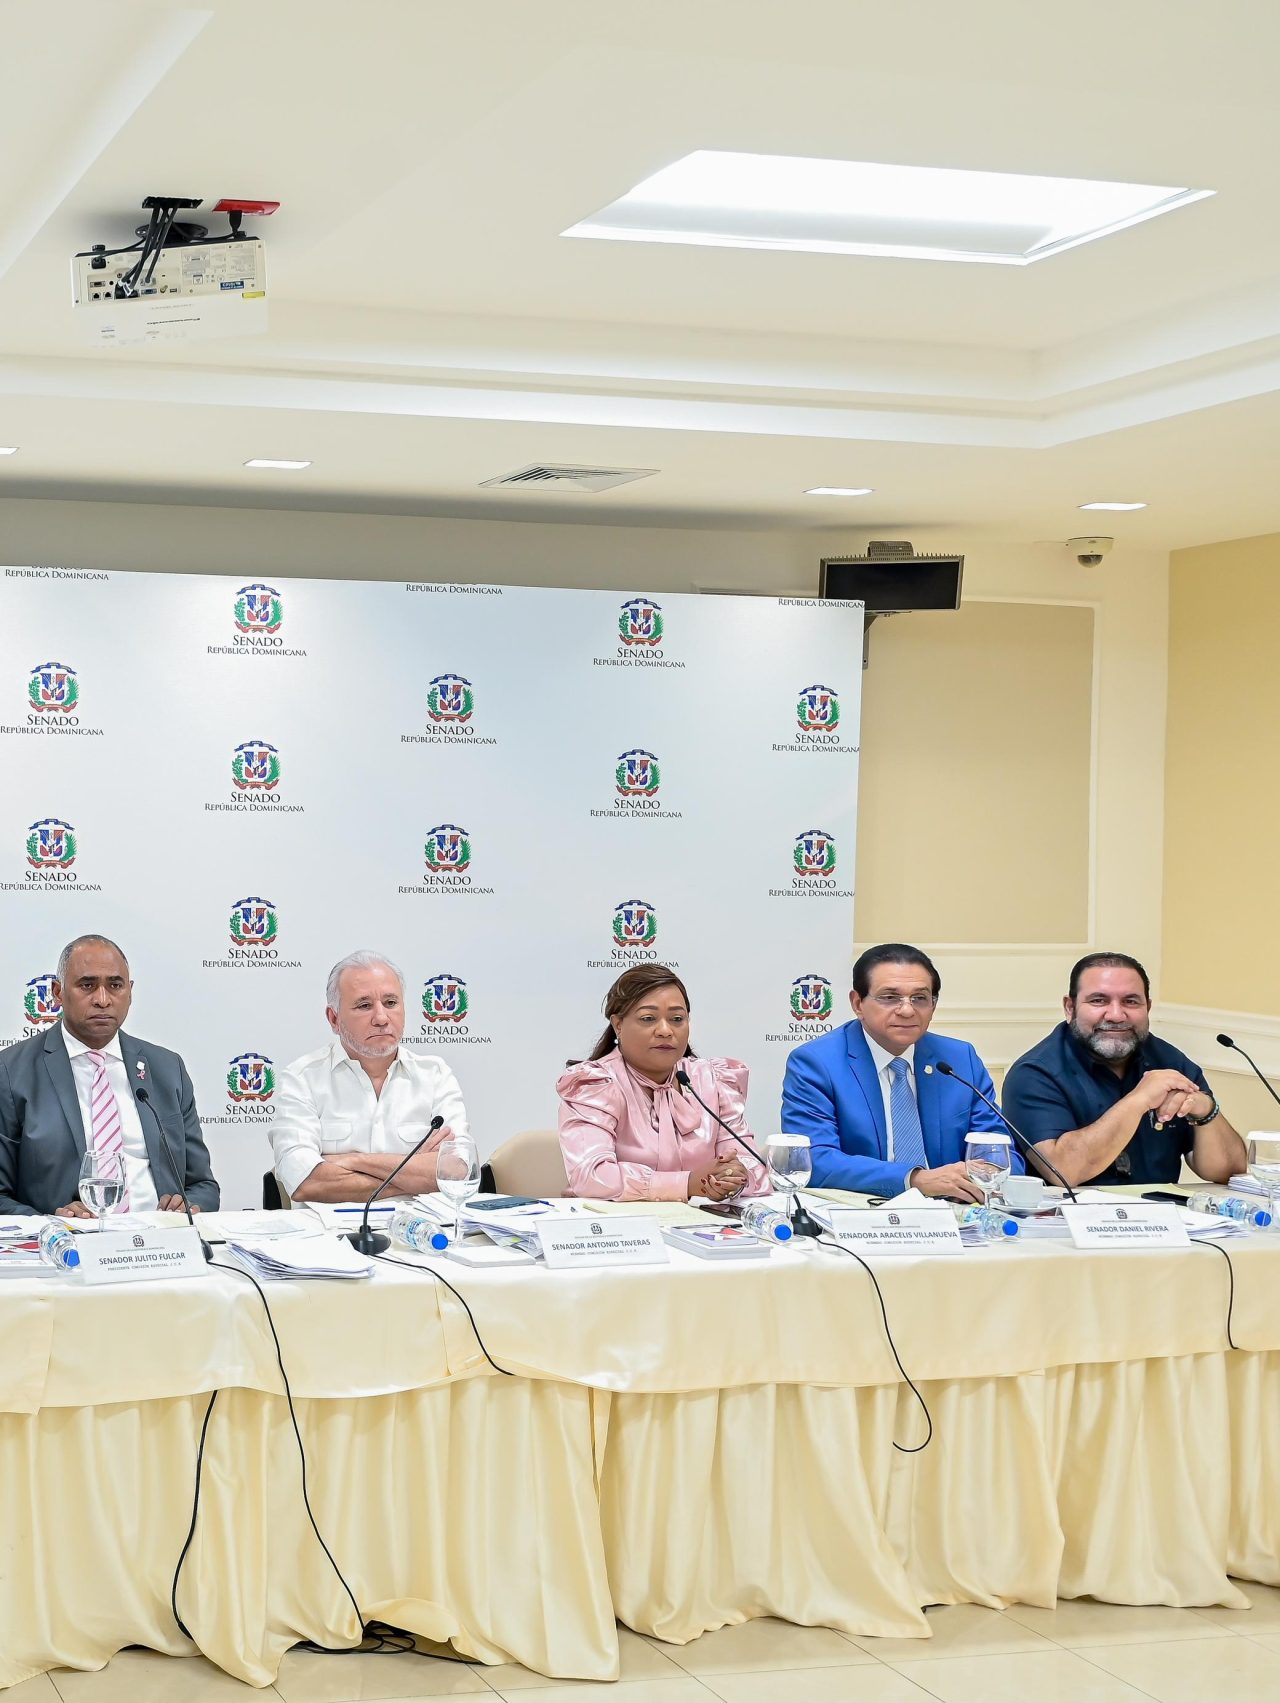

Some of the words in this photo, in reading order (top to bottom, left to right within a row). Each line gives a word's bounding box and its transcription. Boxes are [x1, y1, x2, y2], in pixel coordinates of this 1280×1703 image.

[52, 571, 109, 580] DOMINICANA
[450, 586, 502, 594] DOMINICANA
[233, 635, 283, 646] SENADO
[252, 648, 307, 656] DOMINICANA
[617, 647, 663, 659] SENADO
[635, 660, 685, 668] DOMINICANA
[27, 714, 79, 726] SENADO
[47, 727, 104, 735] DOMINICANA
[426, 724, 474, 735] SENADO
[795, 733, 839, 744] SENADO
[231, 792, 280, 803] SENADO
[250, 804, 304, 812] DOMINICANA
[614, 798, 660, 809] SENADO
[25, 871, 77, 882] SENADO
[423, 874, 471, 885] SENADO
[45, 883, 101, 891] DOMINICANA
[792, 878, 836, 888] SENADO
[228, 948, 278, 959] SENADO
[611, 949, 657, 959] SENADO
[421, 1025, 468, 1035] SENADO
[788, 1023, 832, 1033] SENADO
[400, 1036, 437, 1044] EPÚBLICA
[226, 1104, 275, 1115] SENADO
[552, 1242, 586, 1251] SENADOR
[587, 1240, 620, 1250] ANTONIO
[620, 1238, 651, 1247] TAVERAS
[99, 1256, 134, 1265] SENADOR
[135, 1254, 158, 1263] JULITO
[159, 1252, 186, 1260] FULCAR
